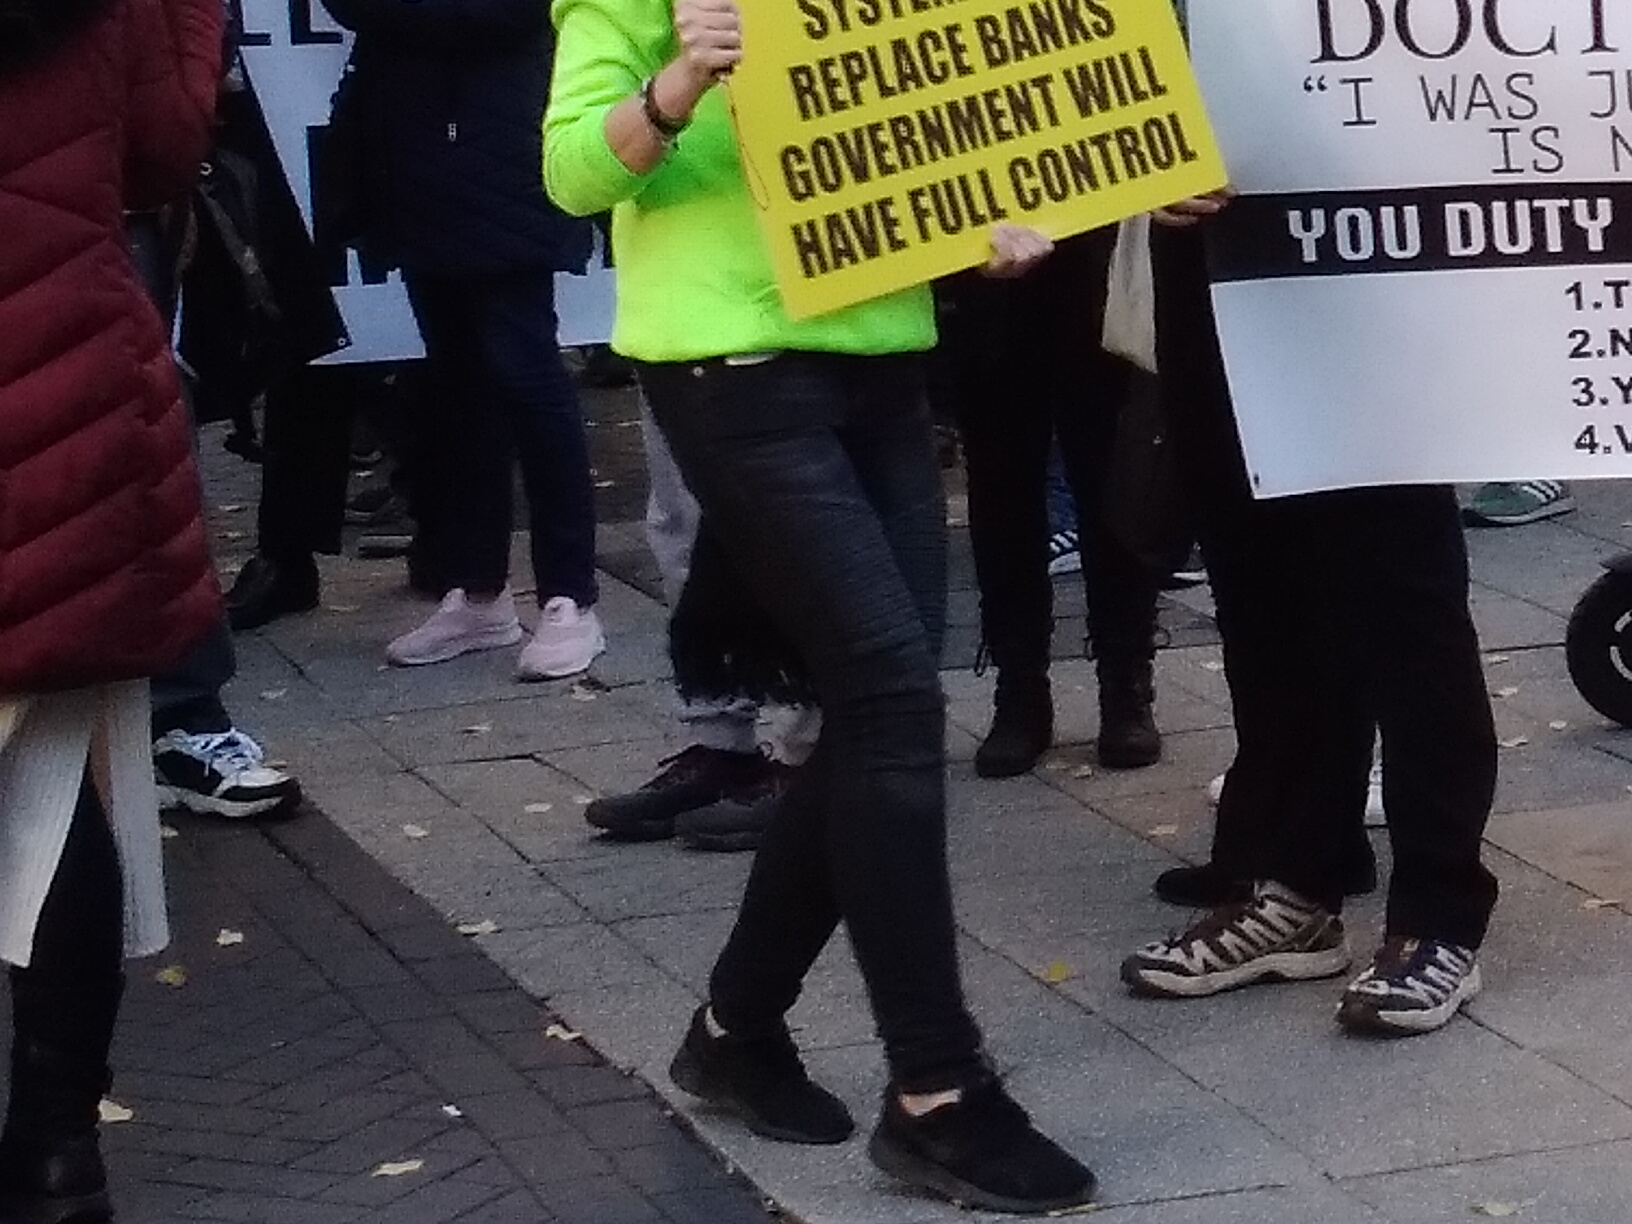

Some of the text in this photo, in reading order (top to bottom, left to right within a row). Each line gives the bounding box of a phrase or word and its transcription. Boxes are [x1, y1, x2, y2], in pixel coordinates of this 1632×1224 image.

[787, 24, 977, 122] REPLACE
[1420, 72, 1539, 122] WAS
[778, 46, 1168, 204] GOVERNMENT WILL
[1488, 125, 1564, 174] IS
[789, 112, 1198, 279] HAVE FULL CONTROL
[1287, 204, 1422, 264] YOU
[1443, 196, 1614, 257] DUTY
